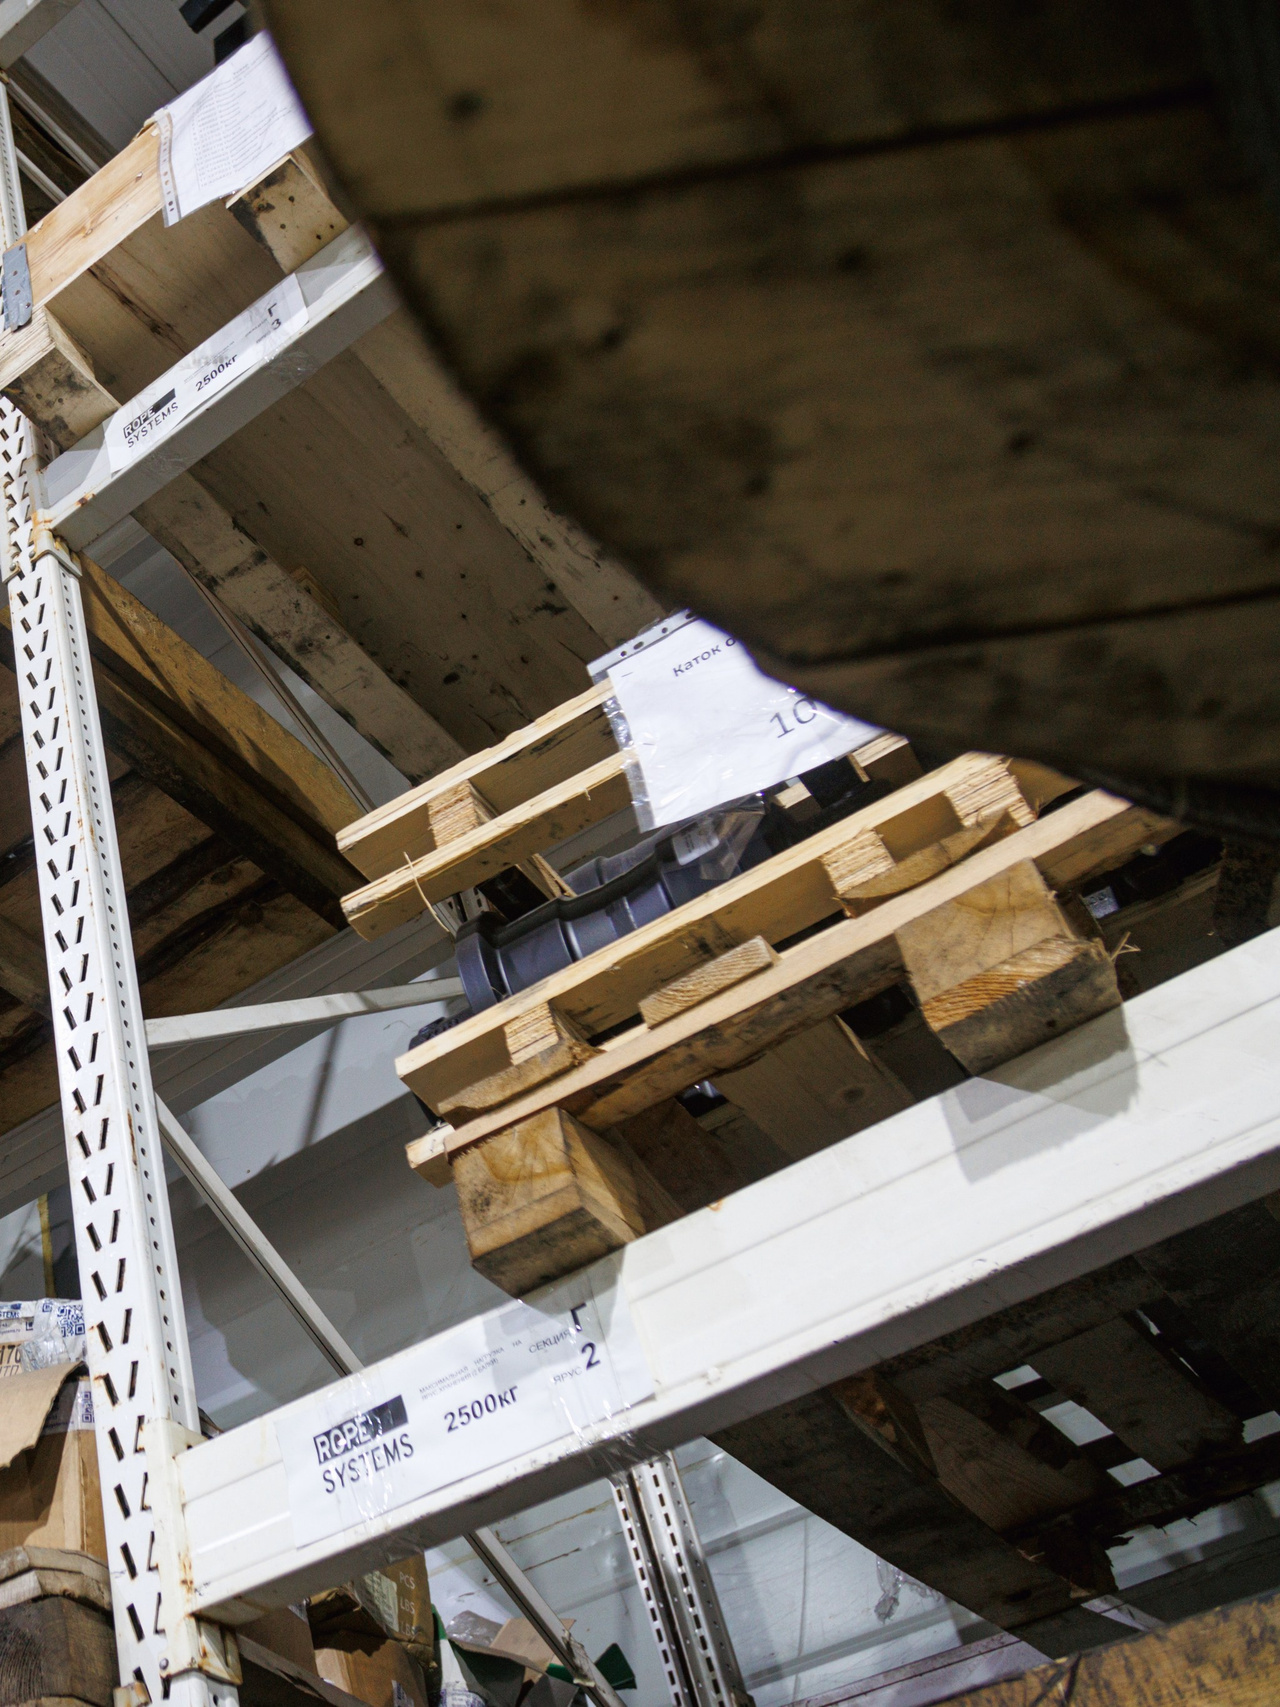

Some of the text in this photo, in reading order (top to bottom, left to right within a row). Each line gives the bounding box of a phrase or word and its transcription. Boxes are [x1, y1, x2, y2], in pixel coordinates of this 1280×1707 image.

[271, 318, 281, 331] 3
[195, 354, 238, 392] 2500кг
[127, 402, 178, 448] SYSTEMS
[672, 645, 722, 677] Каток
[528, 1328, 572, 1353] СЕКЦИЯ
[553, 1342, 601, 1384] ЯРУС 2
[443, 1385, 518, 1434] 2500кг
[314, 1413, 373, 1464] ROPE
[323, 1433, 414, 1494] SYSTEMS
[400, 1571, 416, 1590] PCS
[400, 1595, 416, 1615] LBS
